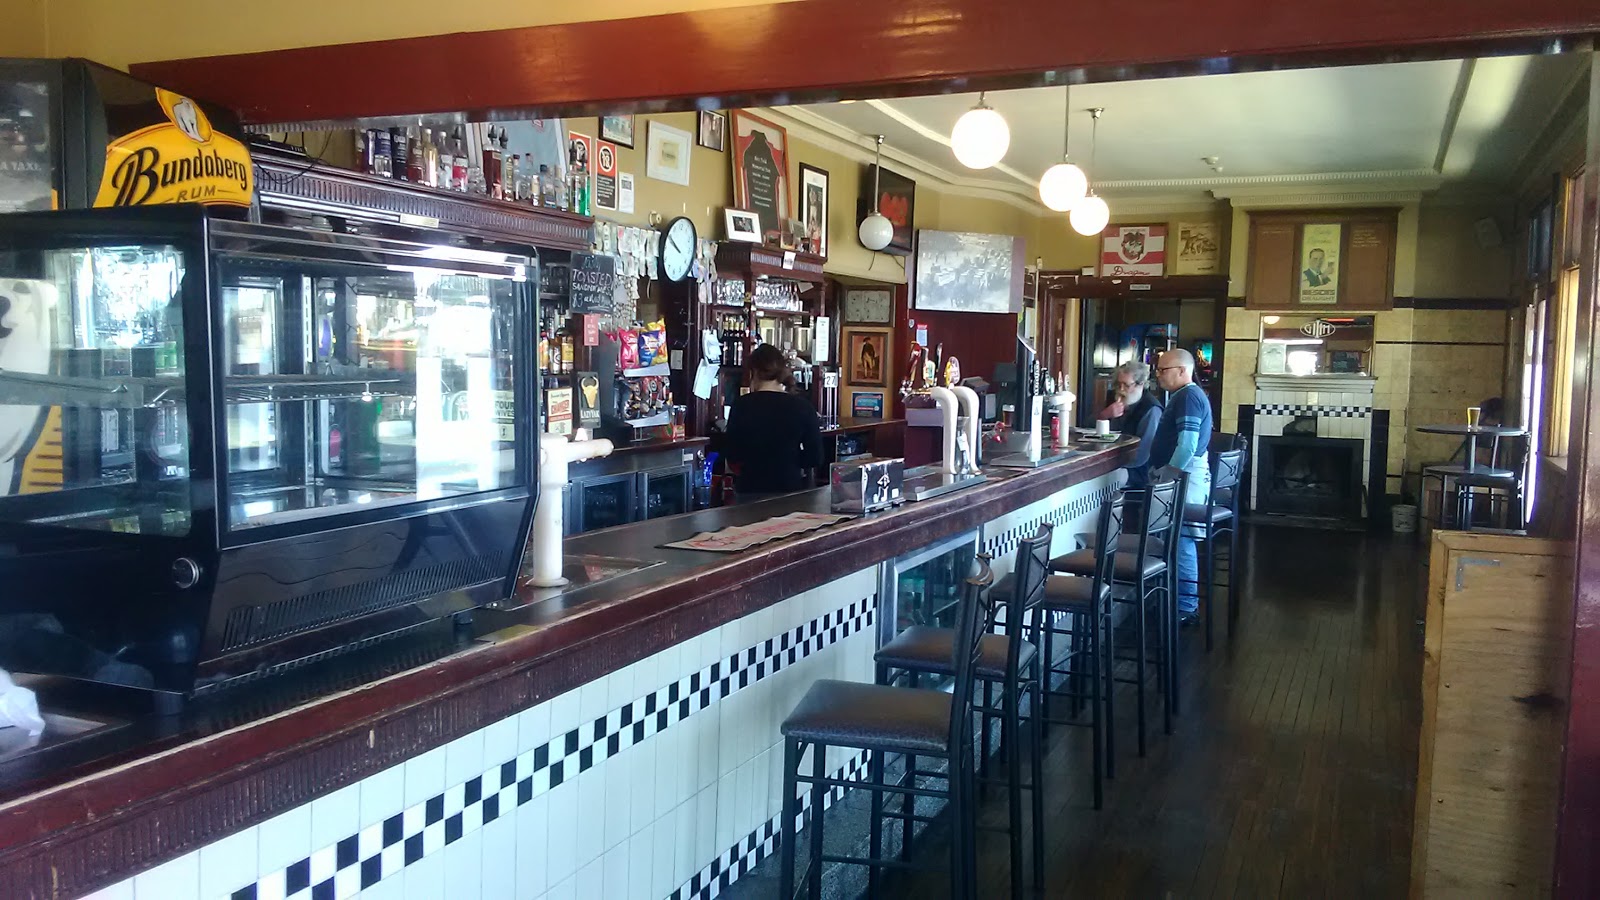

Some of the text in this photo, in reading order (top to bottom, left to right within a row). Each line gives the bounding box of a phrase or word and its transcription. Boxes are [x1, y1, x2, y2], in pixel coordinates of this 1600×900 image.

[111, 146, 247, 206] Bundaberg
[176, 185, 216, 203] RUM
[572, 268, 613, 286] TOASTED
